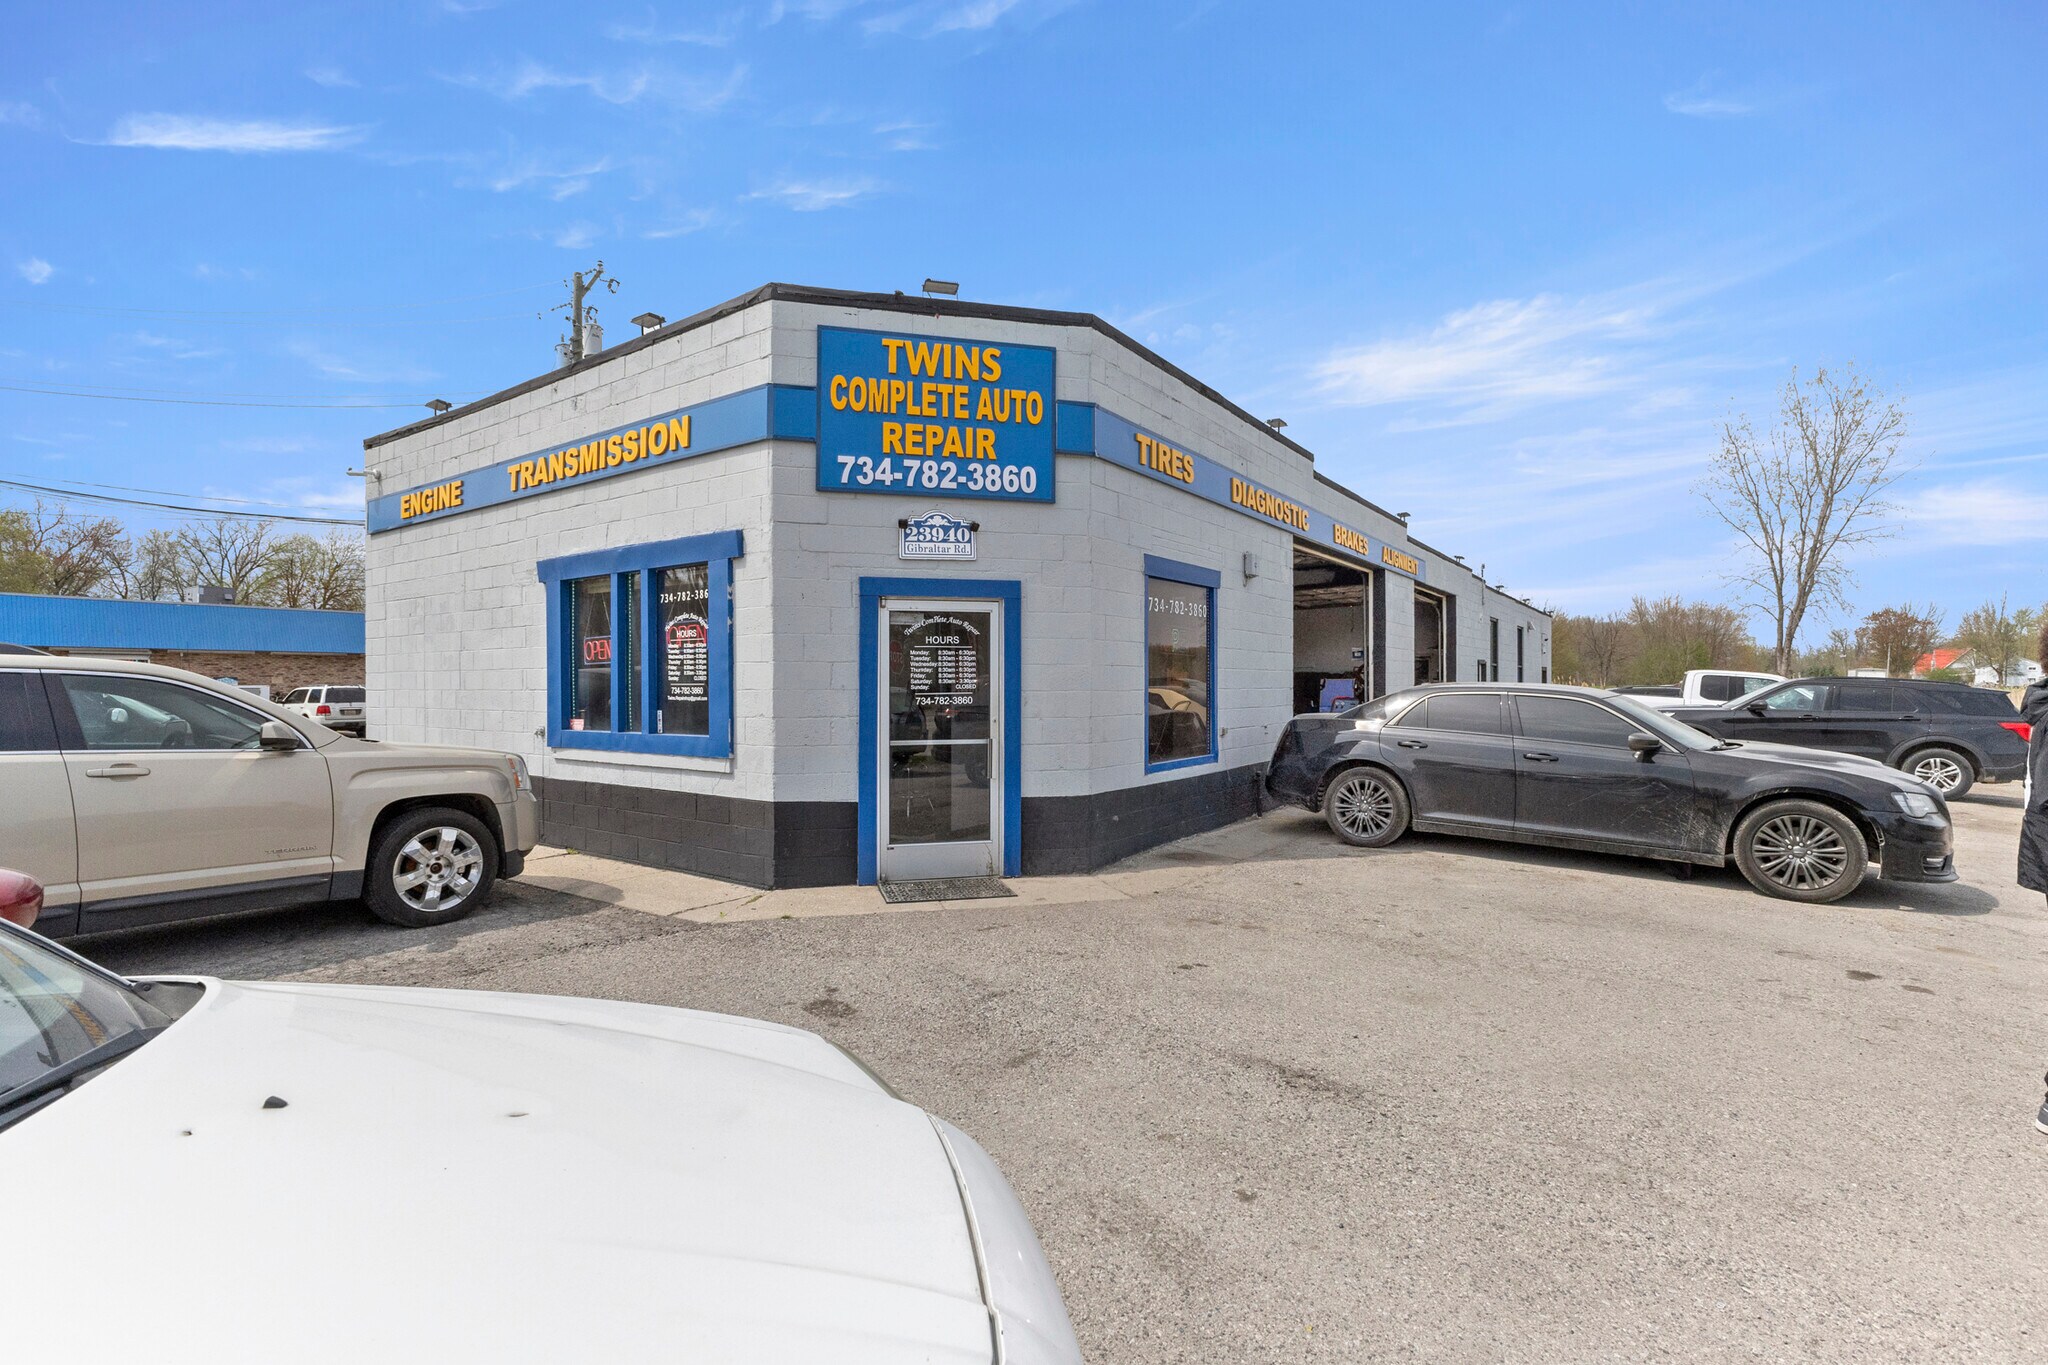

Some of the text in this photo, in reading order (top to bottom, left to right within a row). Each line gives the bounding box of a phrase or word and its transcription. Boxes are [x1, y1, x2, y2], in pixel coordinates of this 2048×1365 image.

[881, 338, 1002, 382] TWINS
[830, 374, 1044, 425] COMPLETE AUTO
[507, 415, 691, 491] TRANSMISSION
[882, 421, 997, 460] REPAIR
[1135, 432, 1195, 484] TIRES
[837, 455, 1037, 494] 734-782-3860
[400, 479, 464, 520] ENGINE
[1230, 476, 1310, 532] DIAGNOSTIC
[905, 526, 970, 543] 23940
[907, 543, 969, 554] Gibraltar Rd.
[1333, 523, 1369, 556] BRAKES
[1381, 545, 1419, 575] ALIGNMENT
[660, 589, 708, 603] 734-782-386
[1148, 596, 1207, 618] 734-782-3860
[677, 630, 697, 638] HOURS
[925, 636, 960, 644] HOURS
[585, 640, 611, 660] OPEN
[915, 696, 973, 705] 734-782-3860
